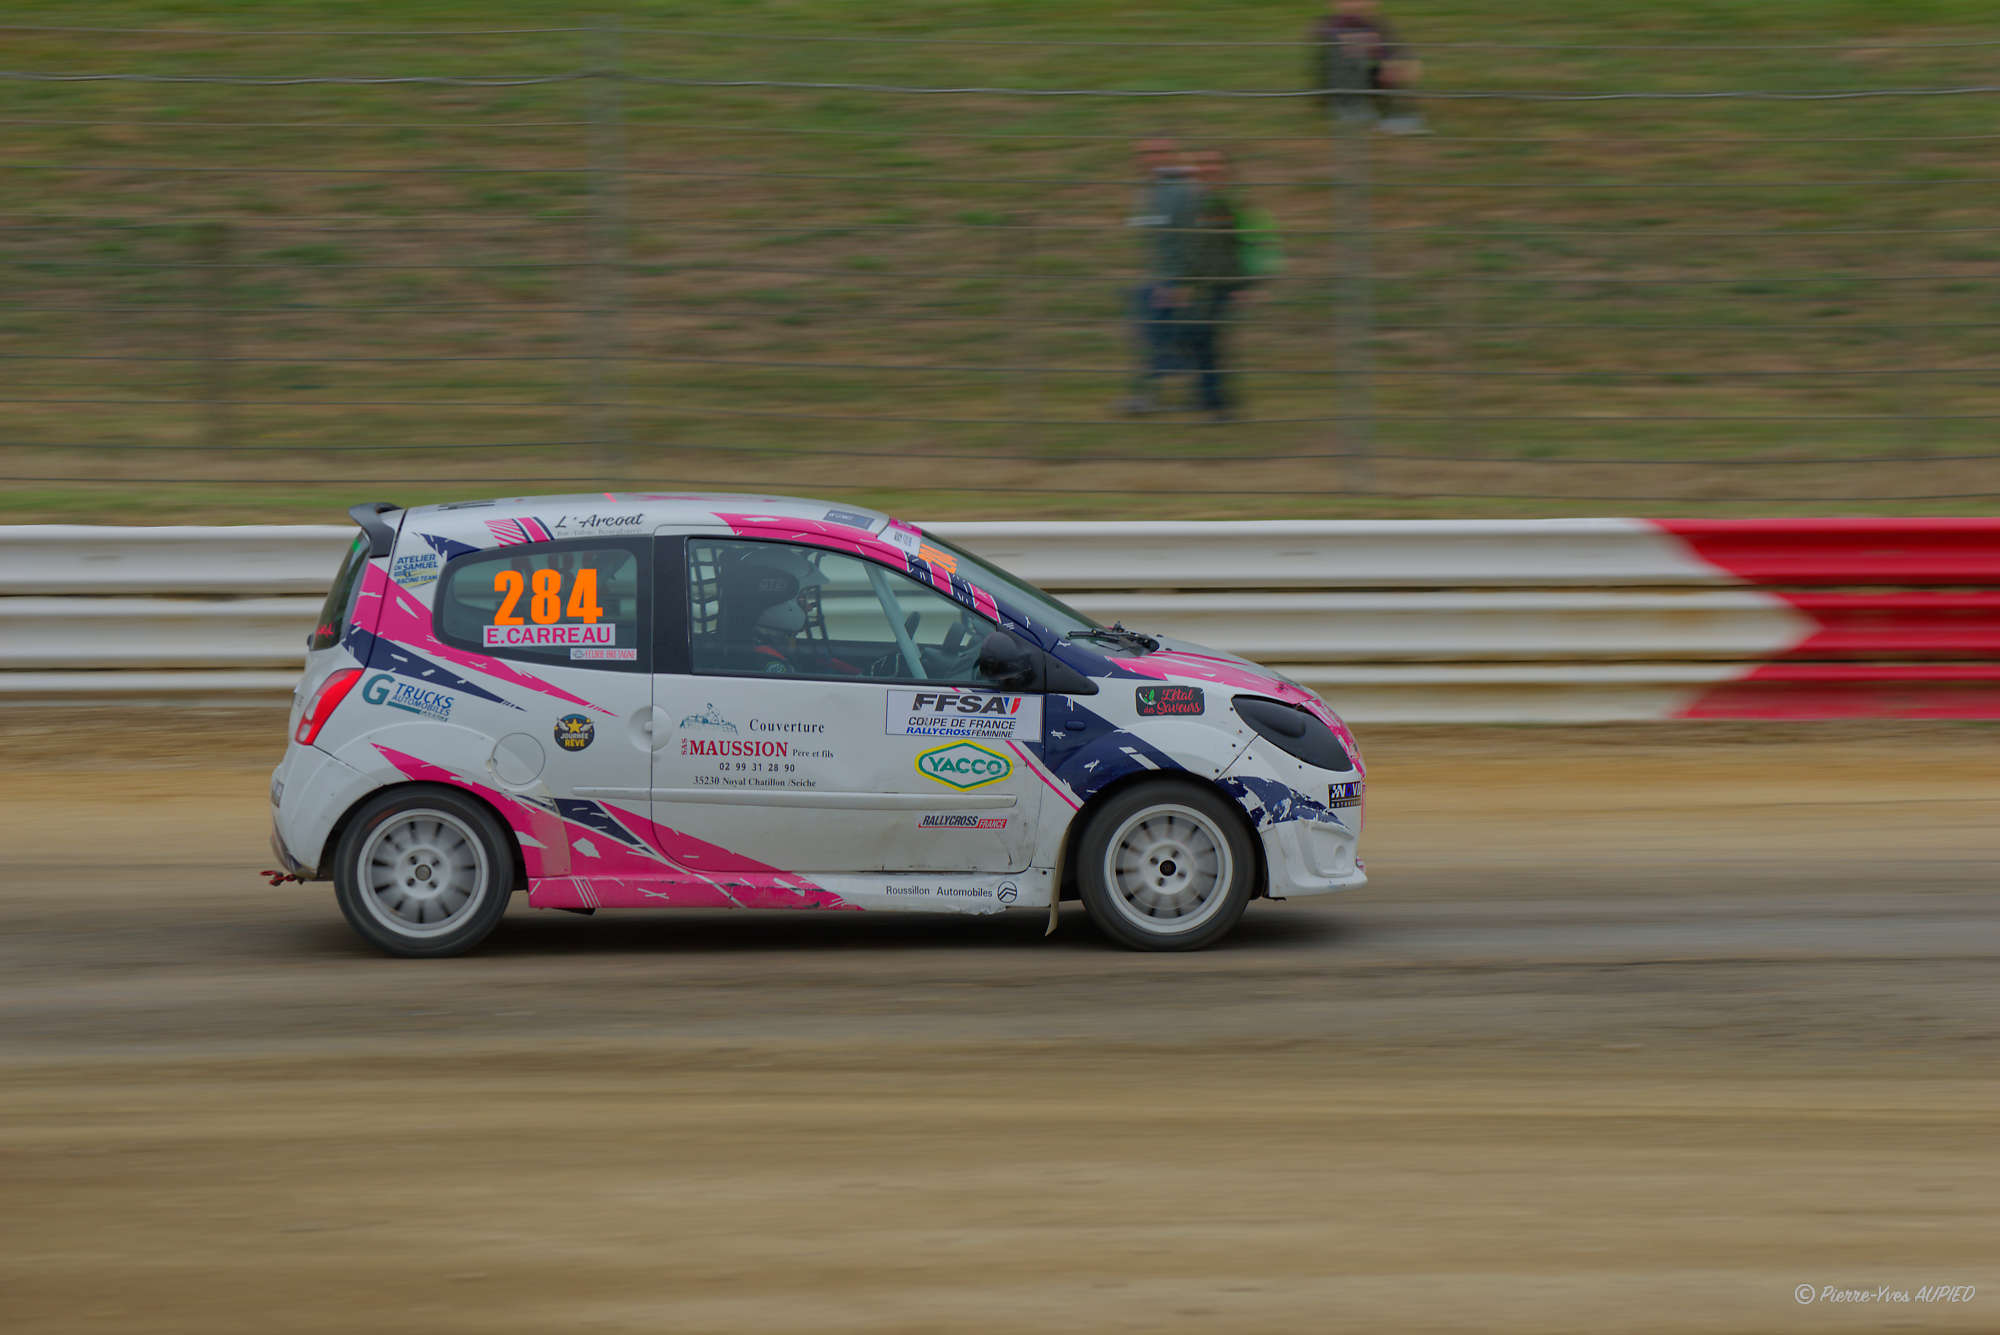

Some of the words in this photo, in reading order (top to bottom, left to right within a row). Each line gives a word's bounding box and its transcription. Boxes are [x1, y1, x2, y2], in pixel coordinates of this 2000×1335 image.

[397, 553, 436, 564] ATELIER
[403, 561, 438, 571] SAMUEL
[494, 568, 604, 626] 284
[487, 627, 610, 644] E.CARREAU
[362, 673, 396, 705] G
[394, 683, 455, 709] TRUCKS
[912, 693, 1007, 715] FFSA
[749, 718, 825, 734] Couverture
[908, 717, 947, 728] COUPE
[950, 718, 966, 728] DE
[969, 719, 1016, 730] FRANCE
[689, 740, 789, 757] MAUSSION
[821, 749, 834, 759] fils
[719, 763, 730, 772] 02
[736, 763, 747, 772] 99
[752, 763, 762, 772] 31
[768, 764, 779, 772] 28
[784, 764, 795, 773] 90
[928, 756, 1003, 776] YACCO
[693, 776, 720, 785] 35230
[722, 777, 746, 788] Noyal
[922, 815, 979, 827] RALLYCROSS
[978, 819, 1007, 829] FRANCE
[886, 886, 930, 896] Roussillon
[936, 886, 993, 898] Automobiles
